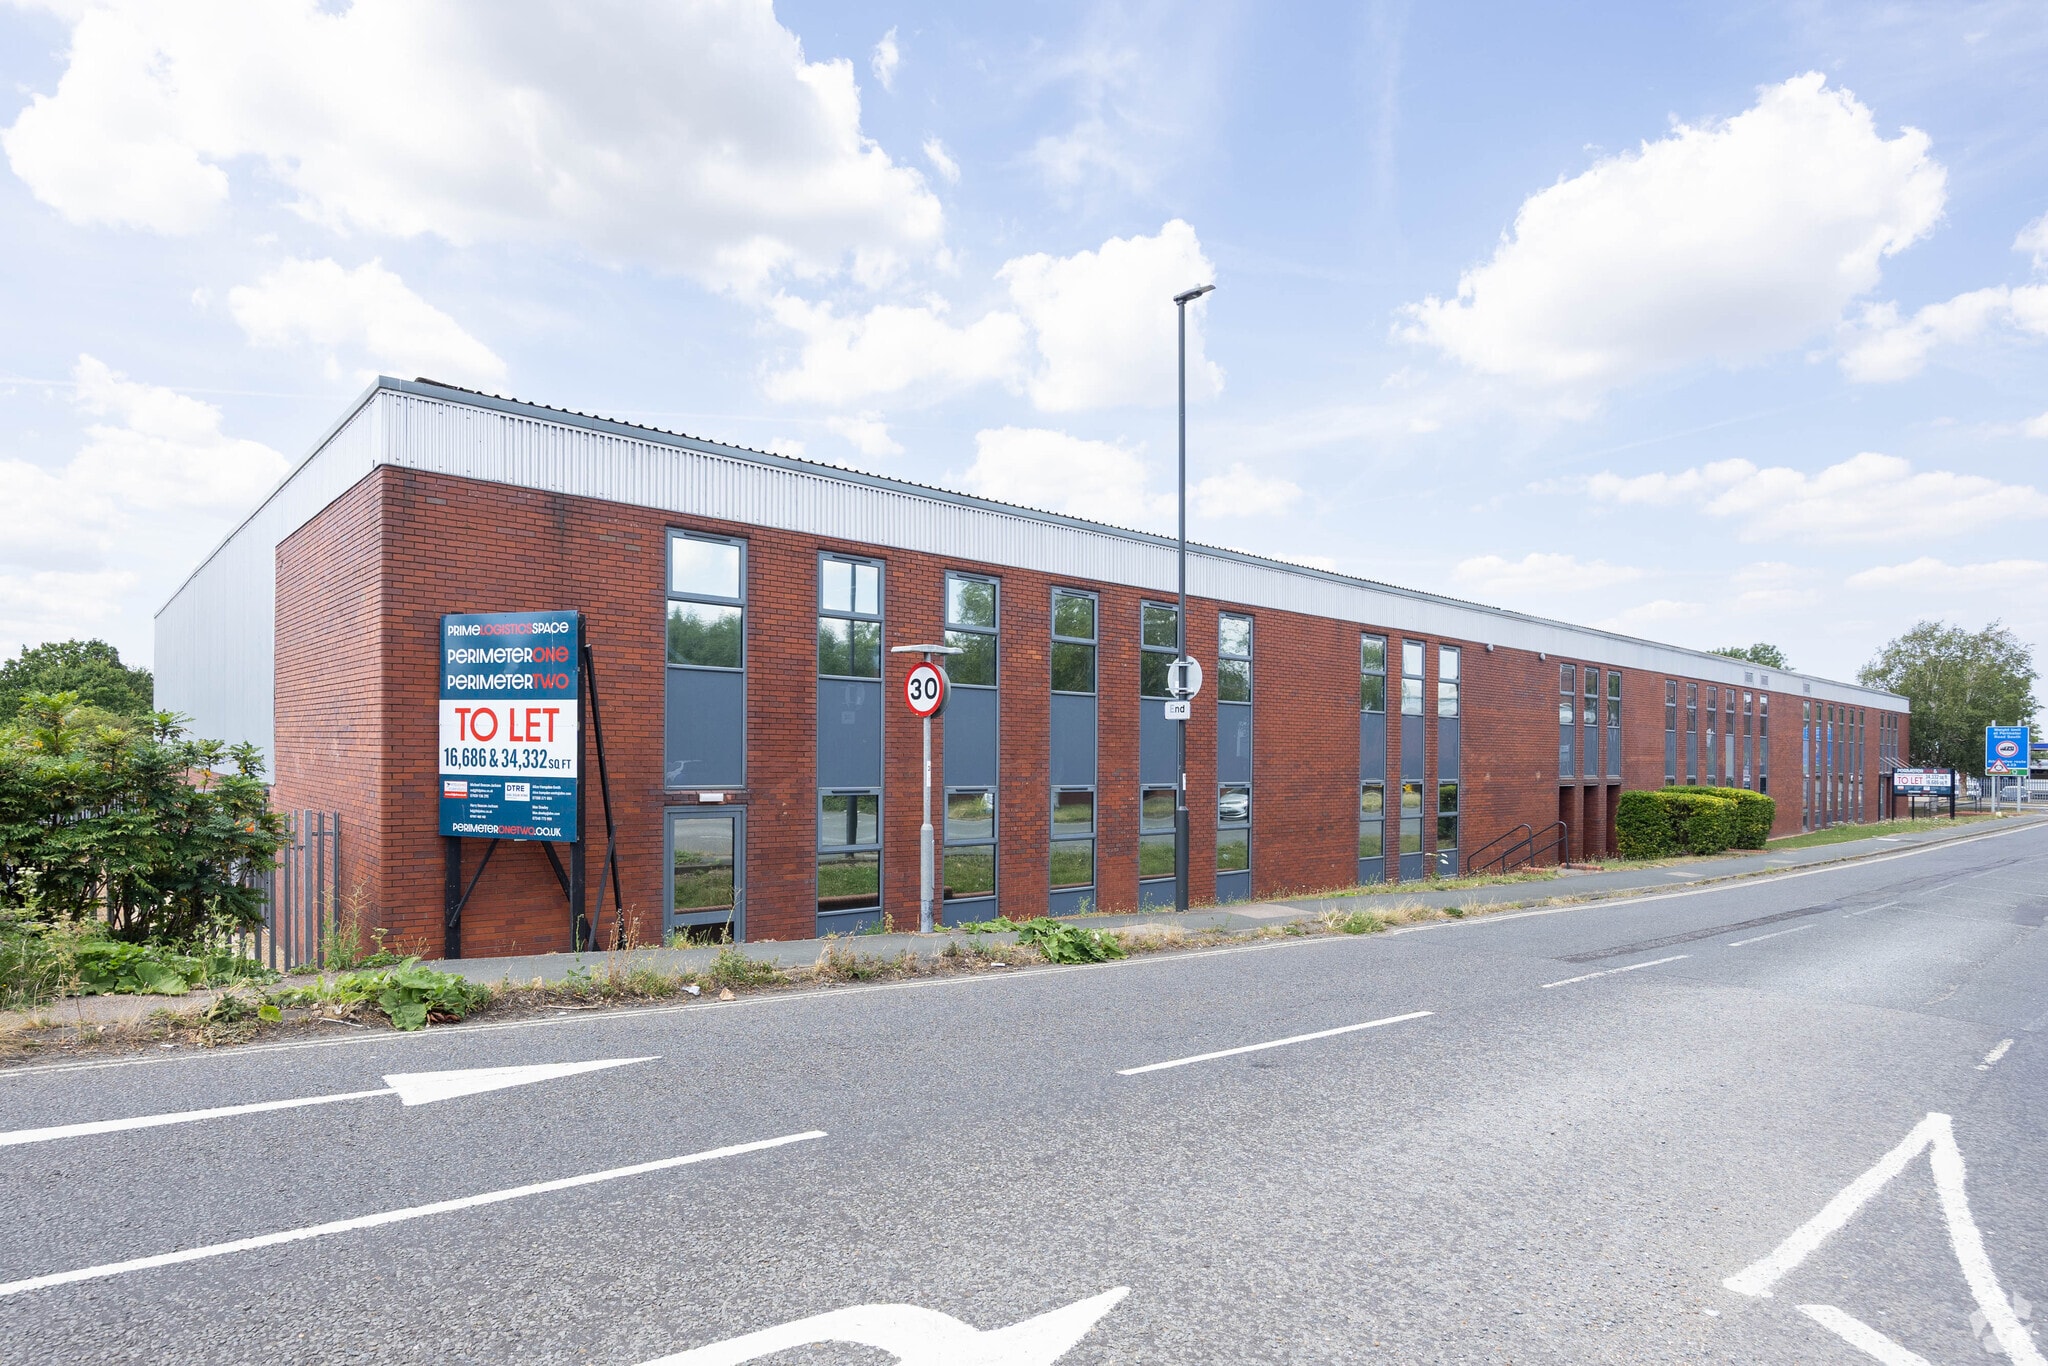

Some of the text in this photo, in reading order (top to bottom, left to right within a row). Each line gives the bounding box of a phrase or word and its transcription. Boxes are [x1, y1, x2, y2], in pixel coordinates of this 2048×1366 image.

[910, 677, 937, 700] 30
[1170, 705, 1185, 713] End
[455, 707, 560, 742] TO LET
[444, 747, 571, 771] 16,686 & 34,332 SQ FT
